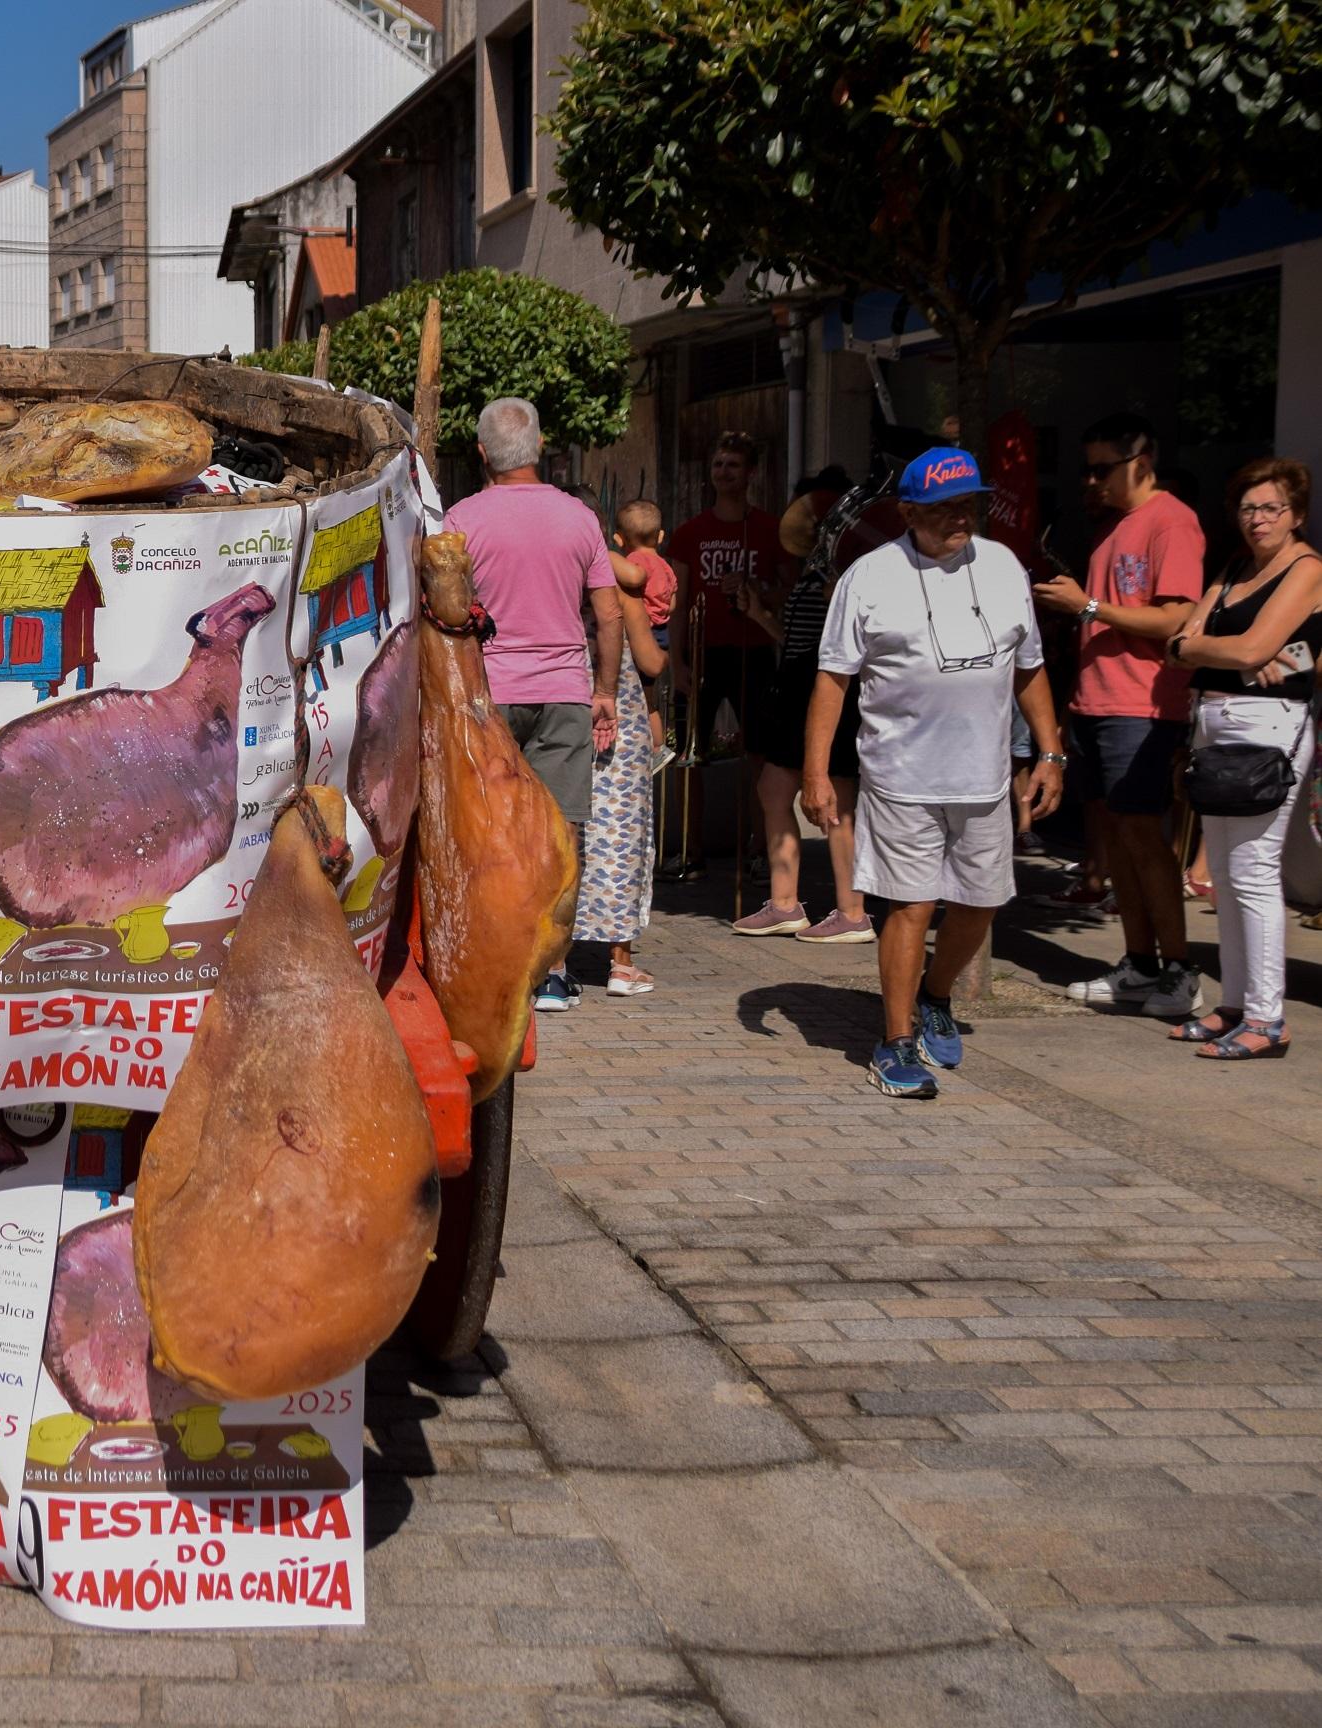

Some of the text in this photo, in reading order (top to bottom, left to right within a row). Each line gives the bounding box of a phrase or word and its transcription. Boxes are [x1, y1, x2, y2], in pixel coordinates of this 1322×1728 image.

[140, 547, 197, 558] CONCELLO
[259, 723, 280, 734] XUNTA
[312, 702, 329, 731] 15
[268, 730, 295, 741] GALICIA
[242, 759, 295, 785] galicia
[240, 831, 271, 850] ABAN
[224, 879, 255, 908] 20
[19, 967, 89, 984] Interese
[95, 967, 169, 984] turístico
[174, 967, 194, 982] de
[109, 1036, 163, 1060] DO
[127, 1063, 167, 1090] NA
[280, 1390, 352, 1415] 2025
[25, 1468, 58, 1482] esta
[88, 1468, 152, 1484] Interese
[48, 1494, 352, 1542] FESTA-FEIRA
[177, 1540, 226, 1566] DO
[52, 1560, 187, 1611] XAMÓN
[196, 1571, 234, 1601] NA
